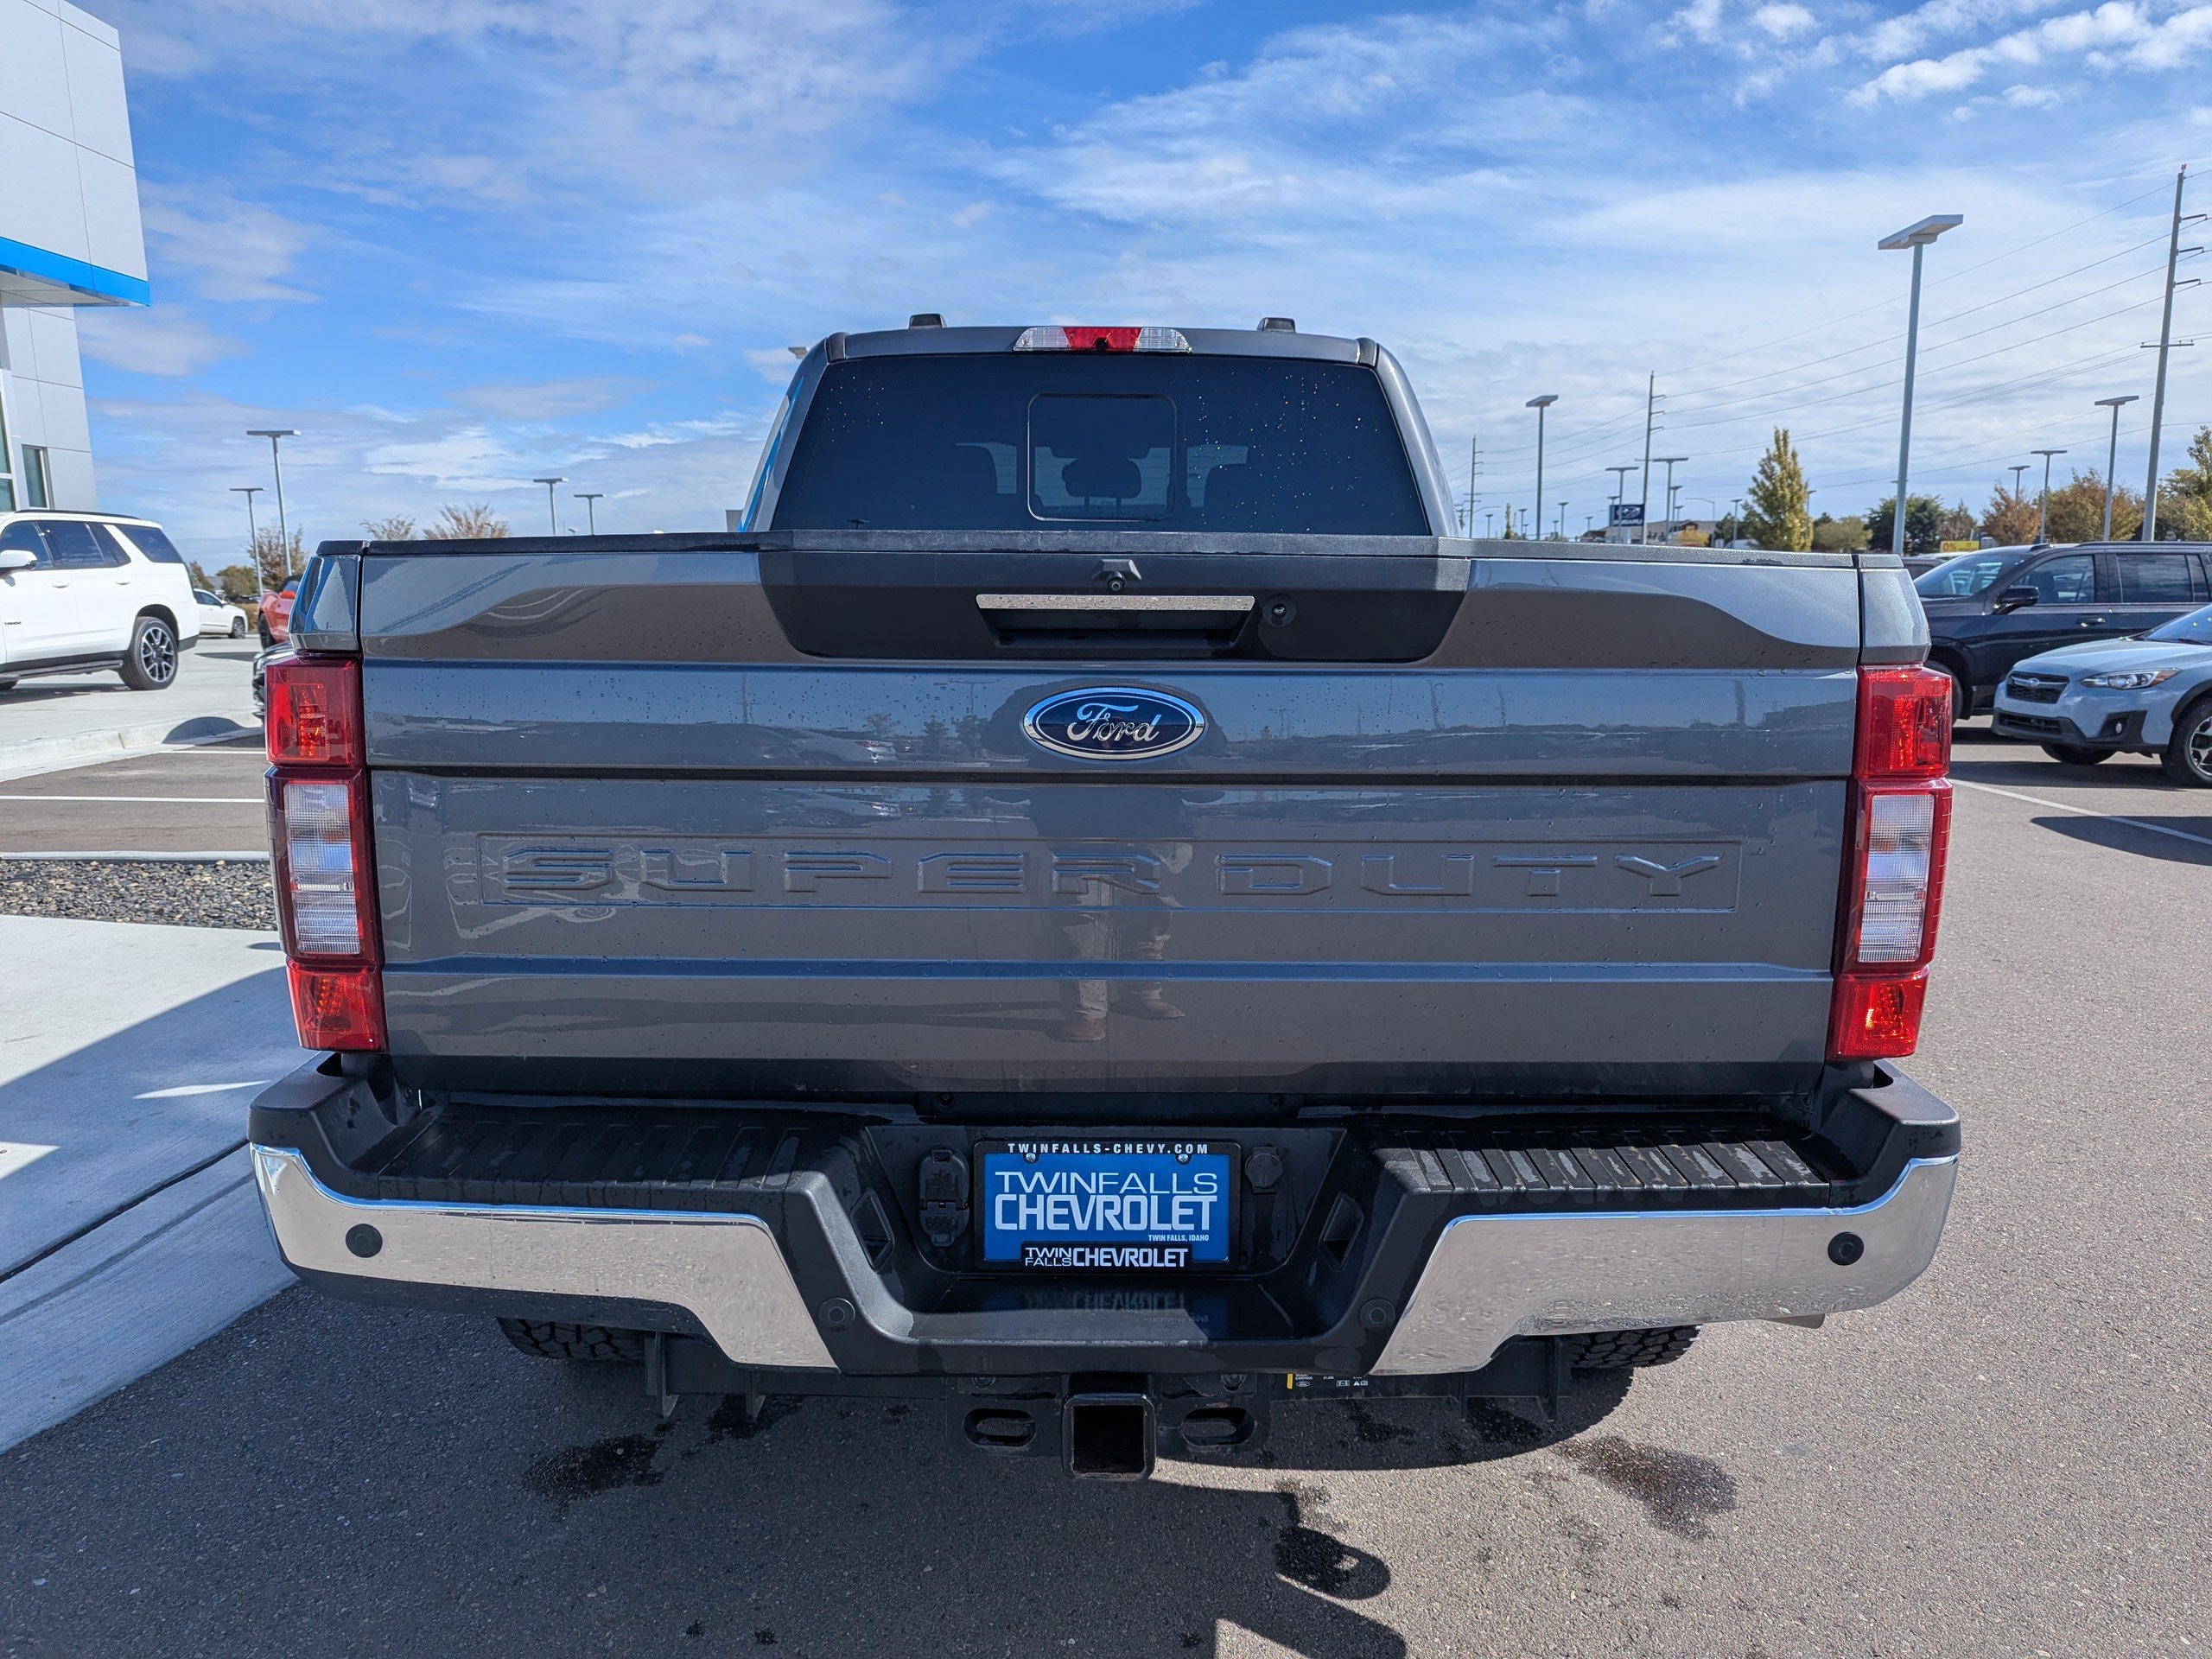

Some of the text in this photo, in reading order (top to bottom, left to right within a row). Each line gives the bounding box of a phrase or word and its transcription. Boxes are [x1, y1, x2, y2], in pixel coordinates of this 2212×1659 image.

[1066, 702, 1162, 741] Ford
[503, 848, 1725, 897] SUPER DUTY
[1007, 1142, 1208, 1154] TWINFALLS-CHEVY.COM
[995, 1194, 1217, 1230] CHEVROLET
[1166, 1234, 1188, 1243] FALLS,
[1025, 1247, 1188, 1268] TWIN CHEVROLET
[1025, 1257, 1072, 1267] FALLS
